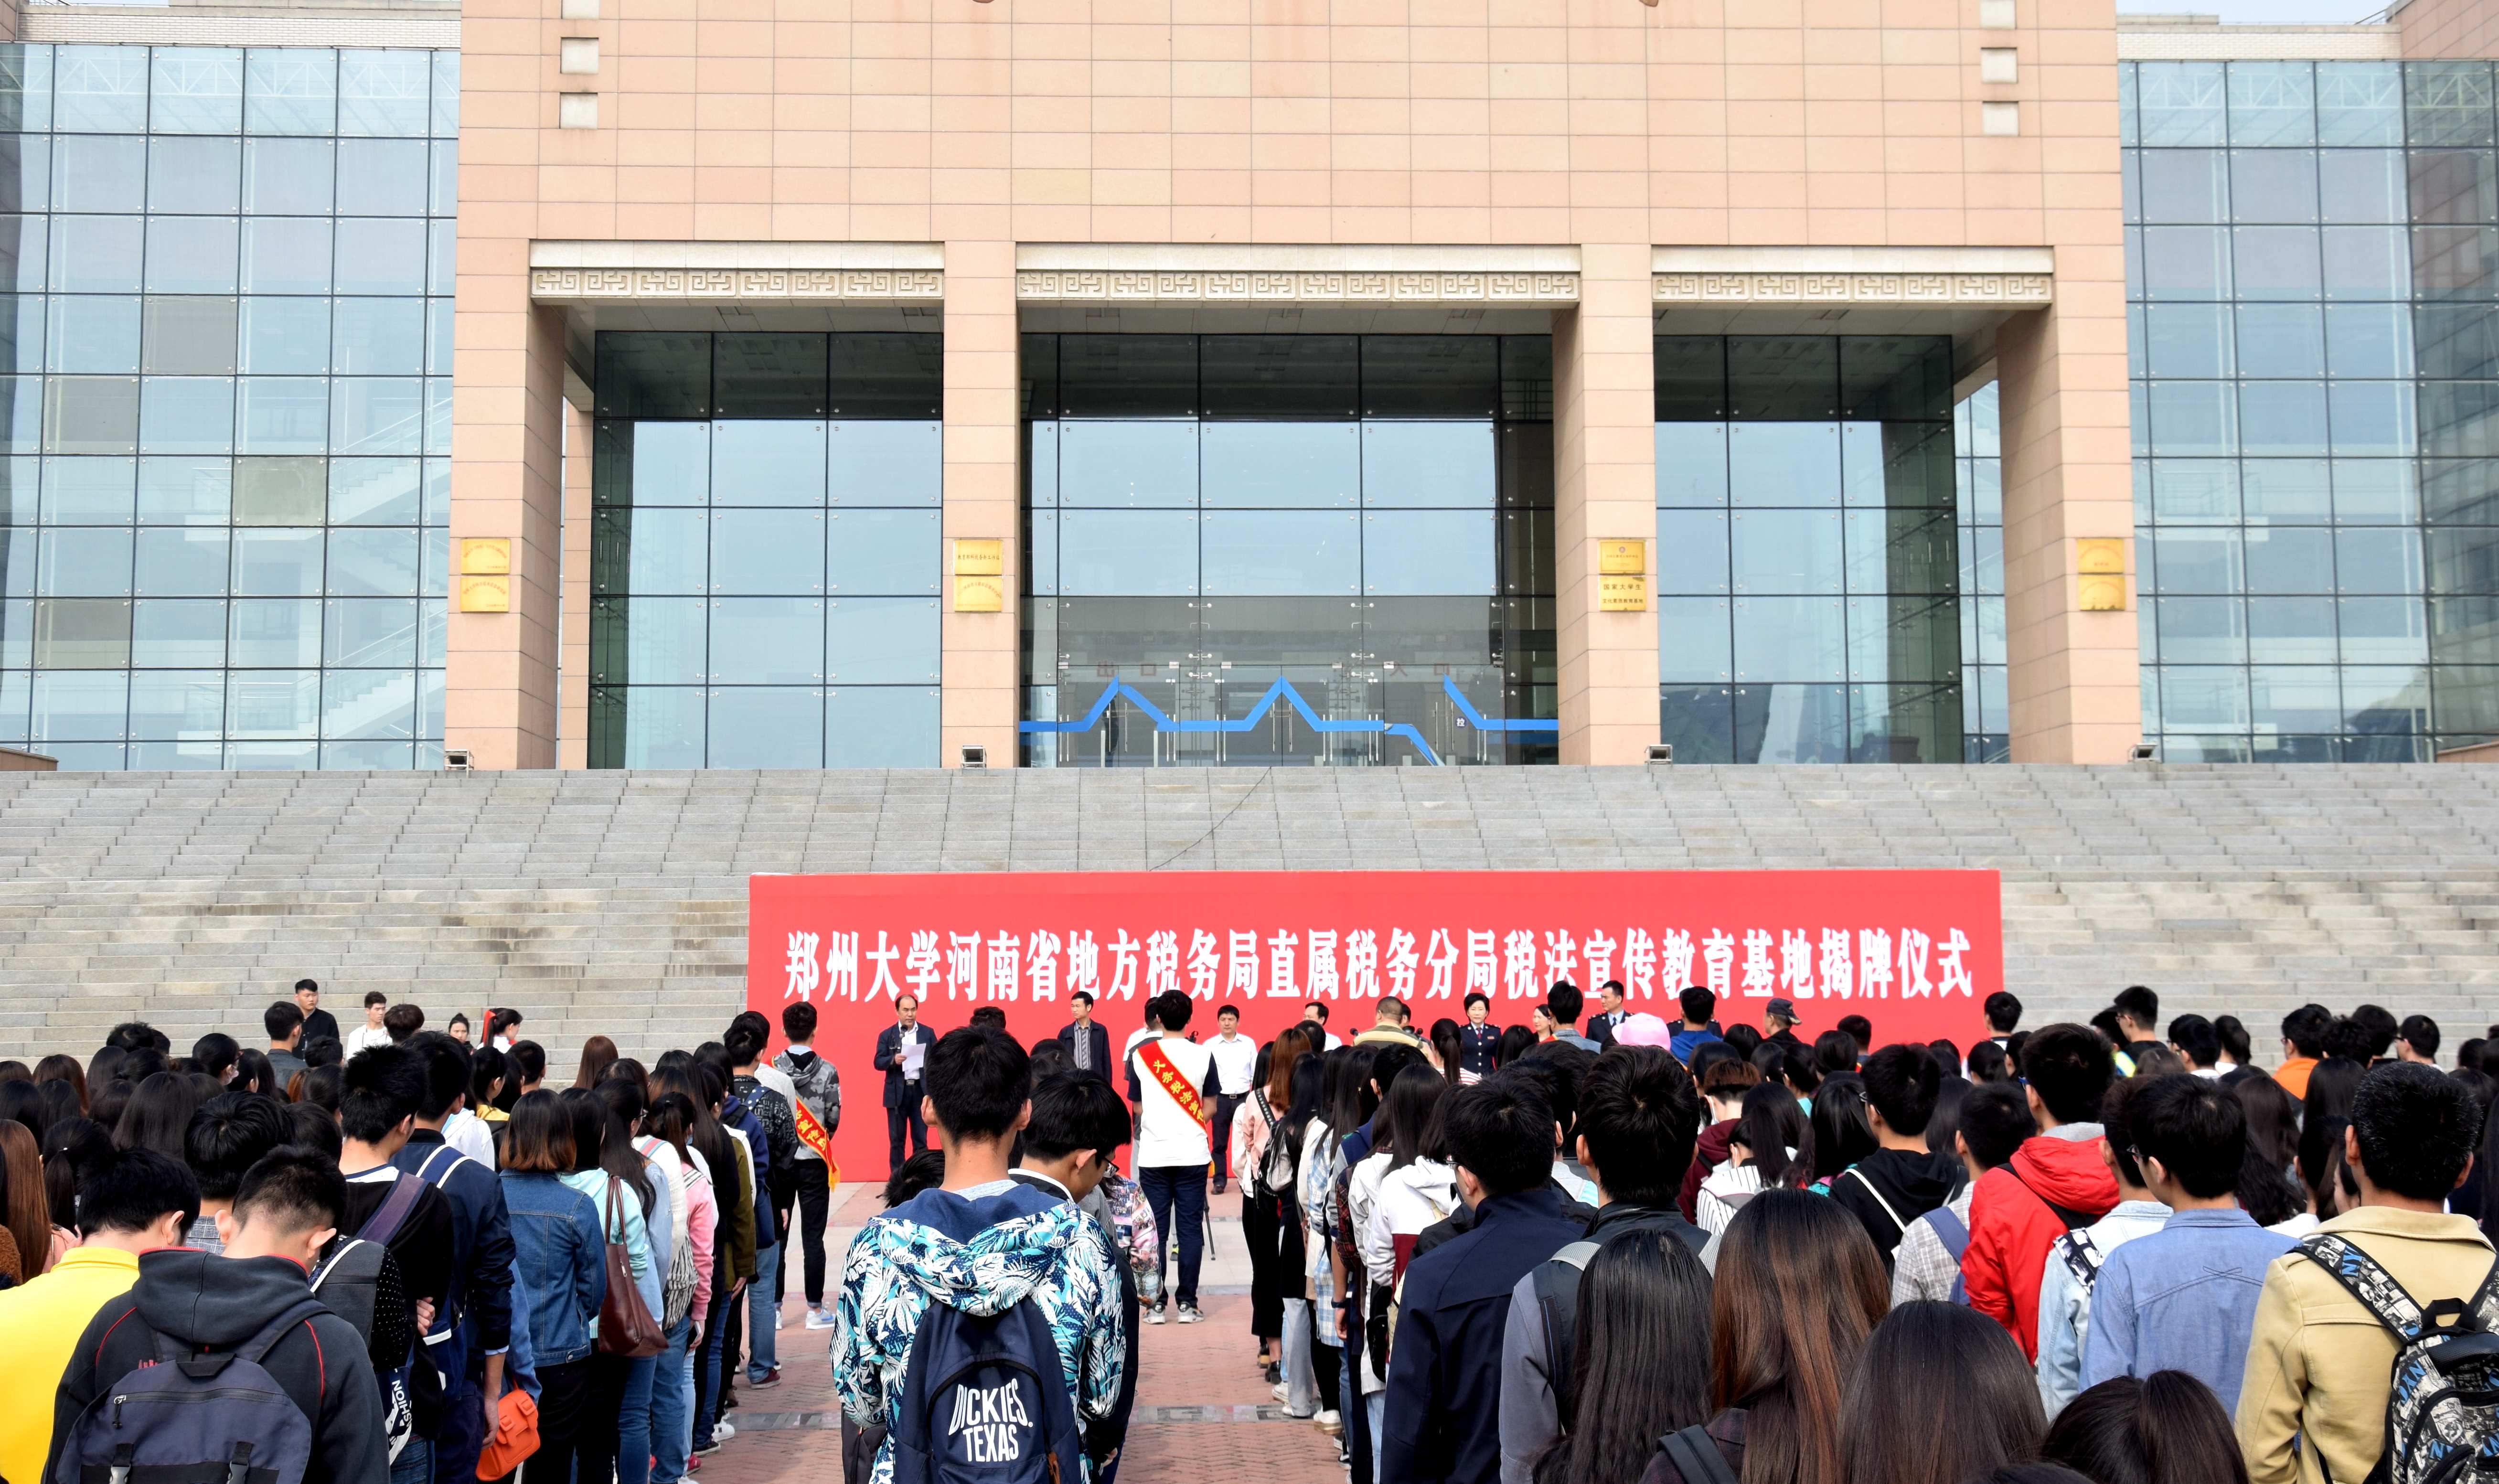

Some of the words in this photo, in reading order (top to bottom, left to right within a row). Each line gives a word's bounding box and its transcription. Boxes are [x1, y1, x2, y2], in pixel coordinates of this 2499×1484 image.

[785, 928, 1972, 1002] 郑州大学河南省地方税务局直属税务分局税法宣传教育基地揭牌仪式
[949, 1378, 1028, 1436] DICKIES
[962, 1423, 1019, 1462] TEXAS
